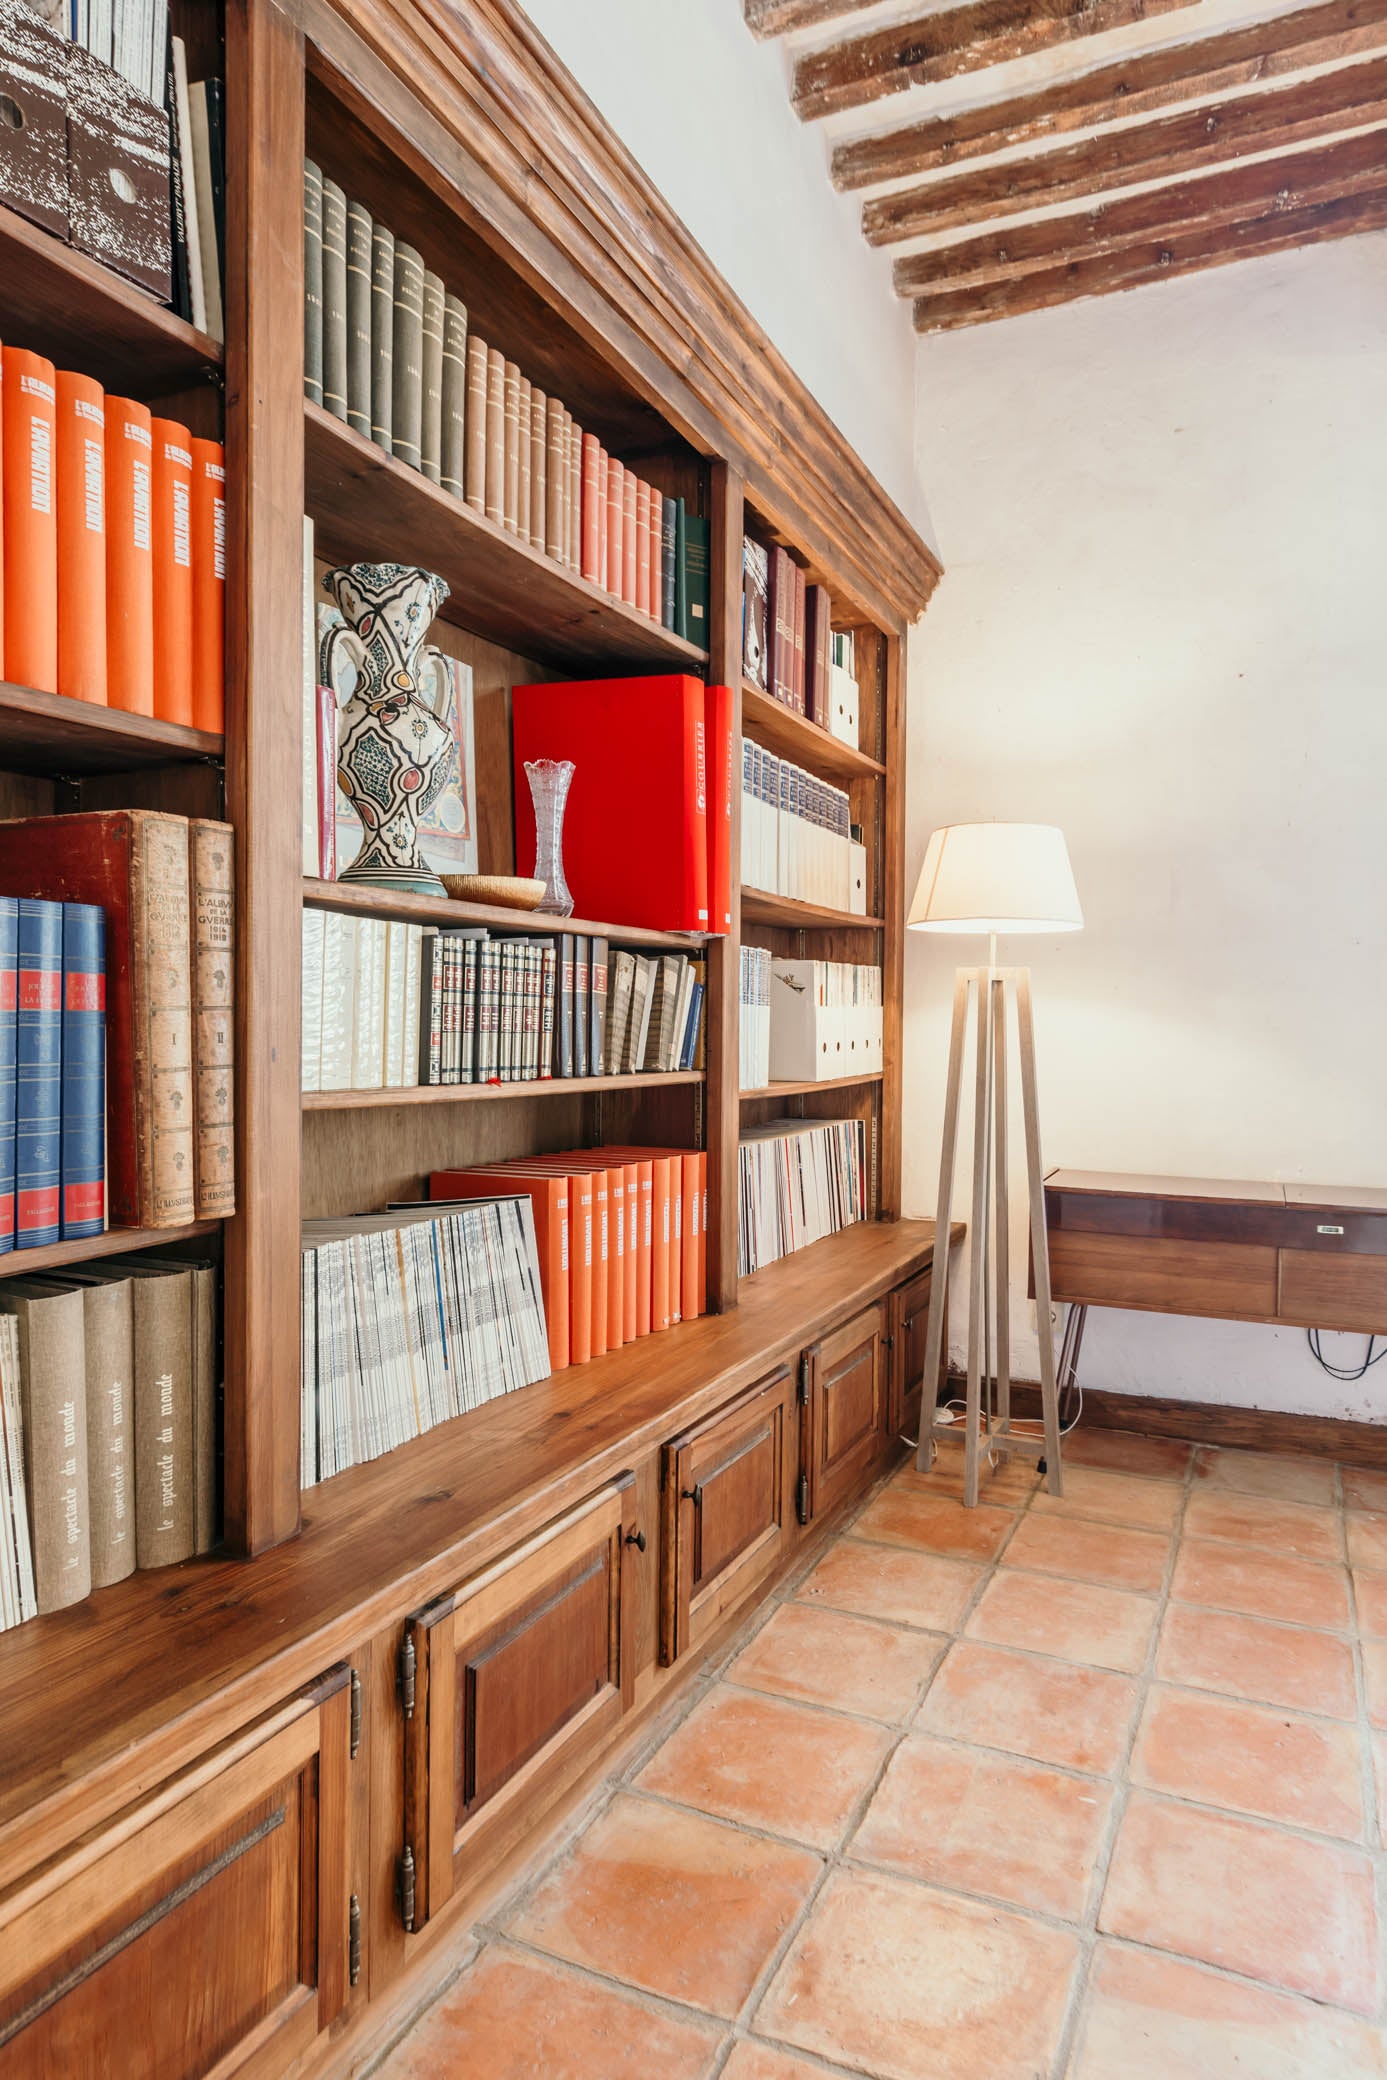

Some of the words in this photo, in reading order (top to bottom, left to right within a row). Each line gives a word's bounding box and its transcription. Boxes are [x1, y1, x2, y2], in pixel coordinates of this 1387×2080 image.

[31, 415, 51, 515] L'AVIATION
[108, 1381, 122, 1426] monde
[155, 1373, 173, 1416] monde
[58, 1401, 75, 1447] monde
[110, 1436, 123, 1453] du
[156, 1426, 173, 1443] du
[60, 1458, 76, 1476] du
[156, 1454, 177, 1507] spectacle
[111, 1465, 126, 1519] spectacle
[61, 1487, 80, 1544] spectacle
[157, 1519, 174, 1531] le
[112, 1532, 126, 1545] le
[64, 1556, 79, 1571] le
